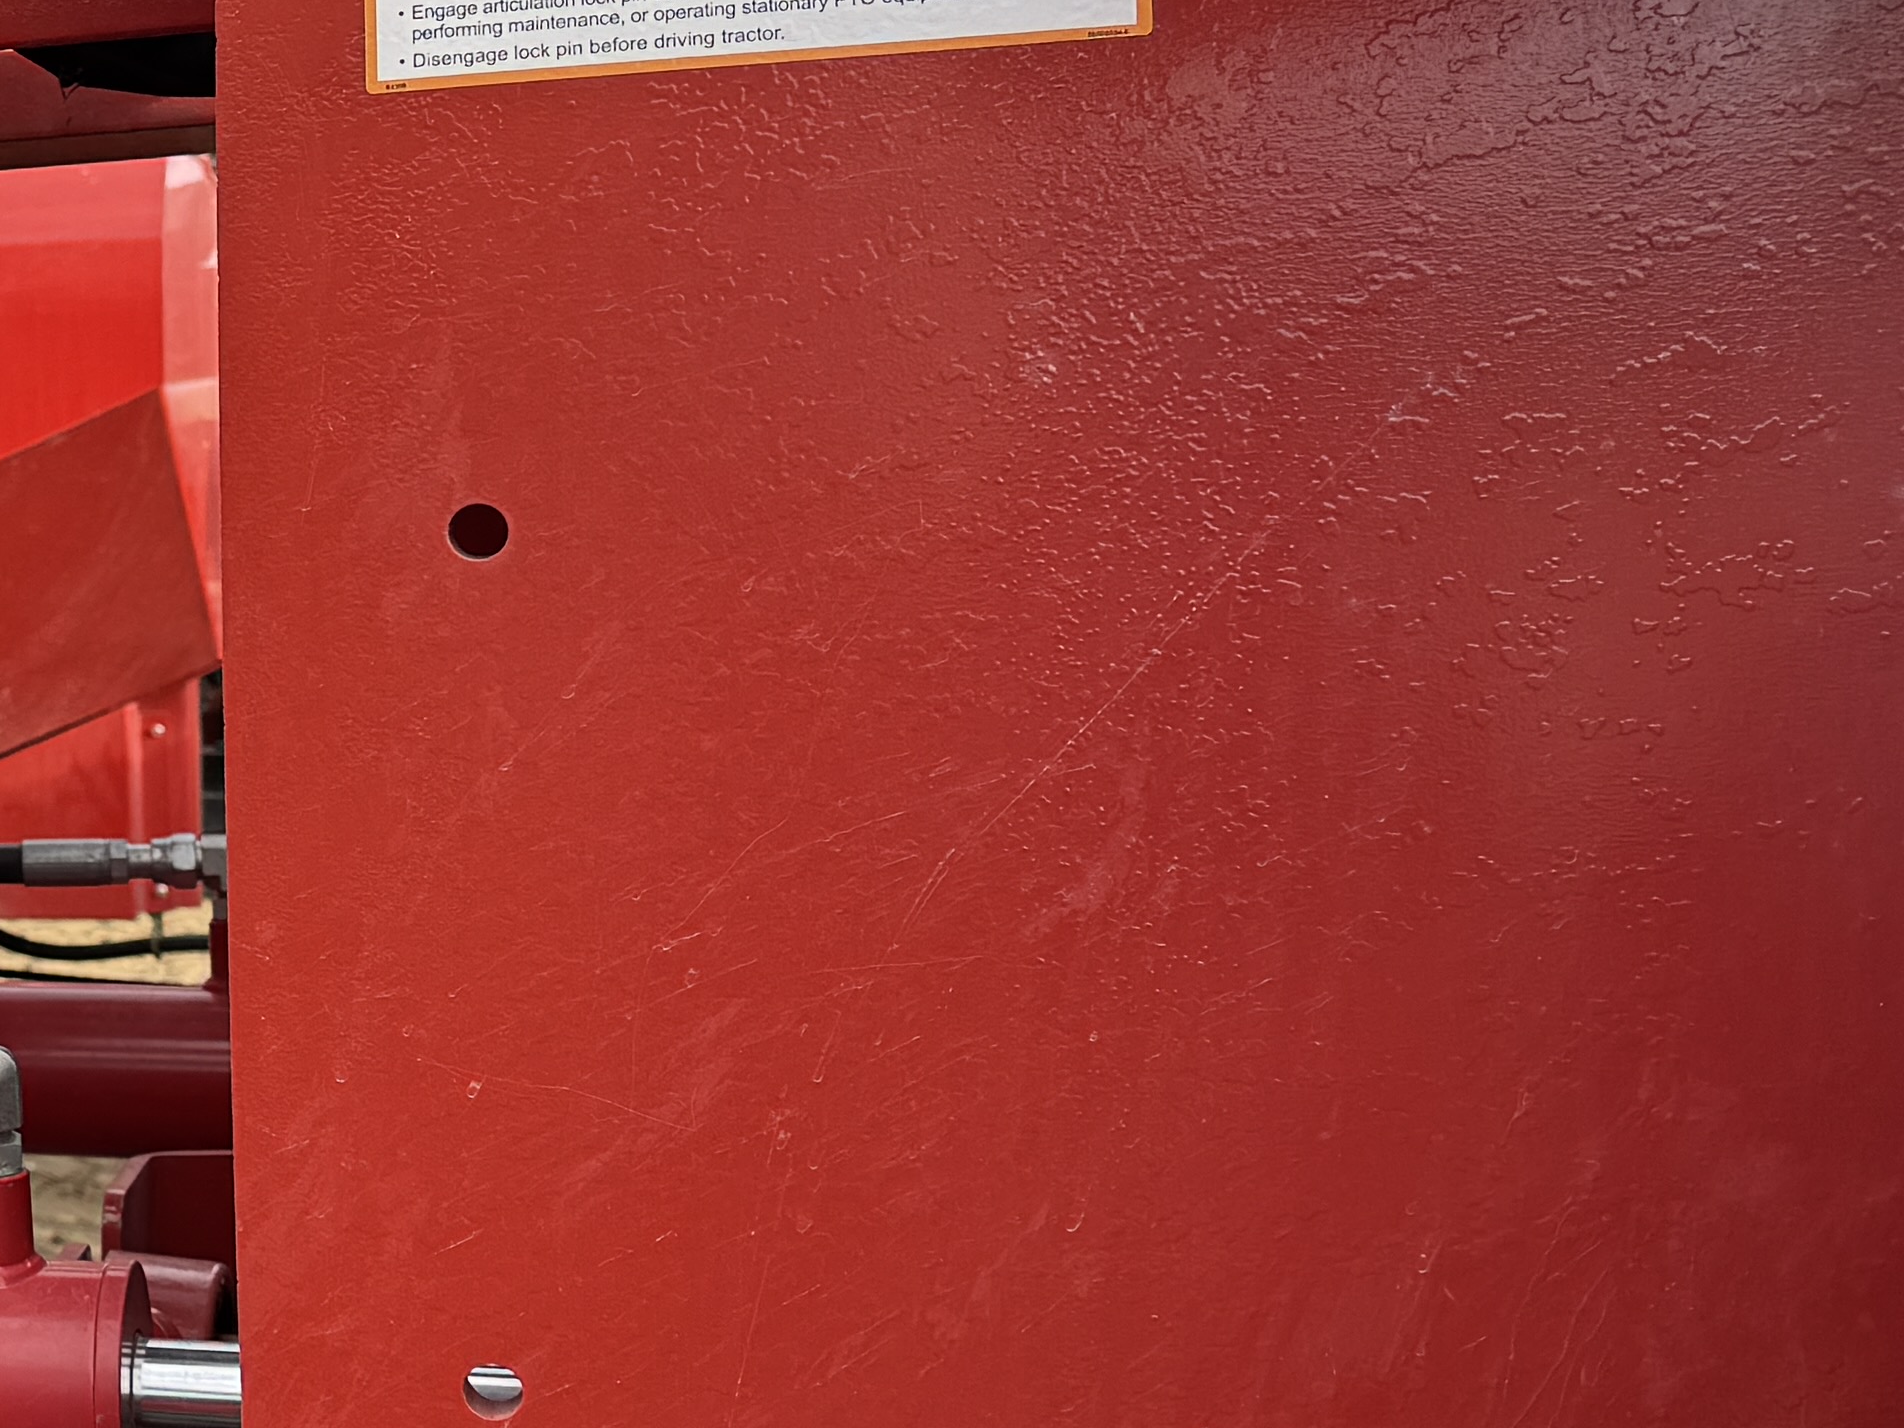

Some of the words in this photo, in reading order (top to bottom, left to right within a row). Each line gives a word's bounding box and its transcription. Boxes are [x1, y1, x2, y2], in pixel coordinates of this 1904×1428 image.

[412, 1, 478, 22] Engage
[412, 23, 503, 44] performing
[508, 12, 624, 34] maintenance,
[630, 10, 649, 23] or
[654, 0, 736, 22] operating
[413, 50, 508, 69] Disengage
[514, 44, 550, 61] lock
[556, 43, 583, 60] pin
[590, 36, 647, 54] before
[654, 31, 715, 50] driving
[721, 27, 784, 44] tractor.
